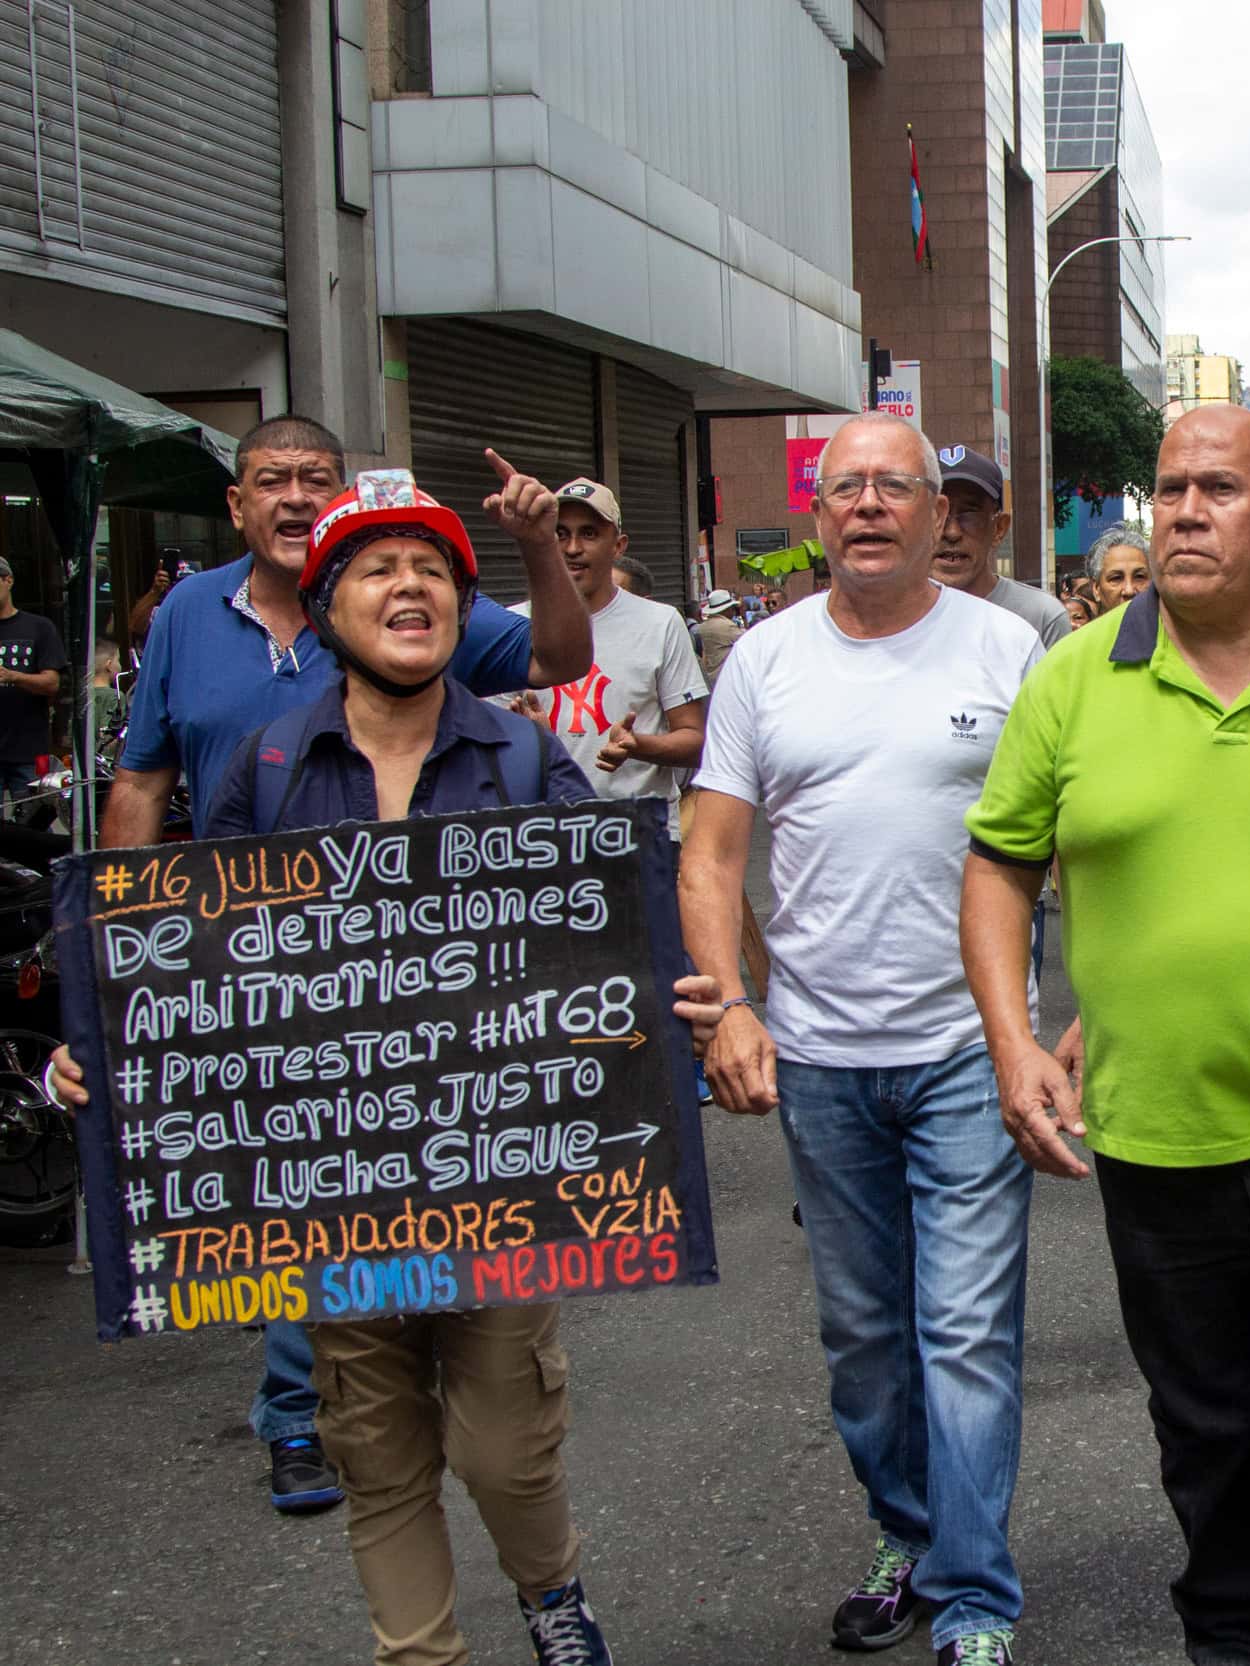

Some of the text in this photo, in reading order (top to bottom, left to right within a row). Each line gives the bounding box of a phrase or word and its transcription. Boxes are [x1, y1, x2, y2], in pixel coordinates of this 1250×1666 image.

[200, 847, 321, 920] JULIO
[556, 1156, 646, 1201] CON
[321, 1252, 459, 1315] SOMOS
